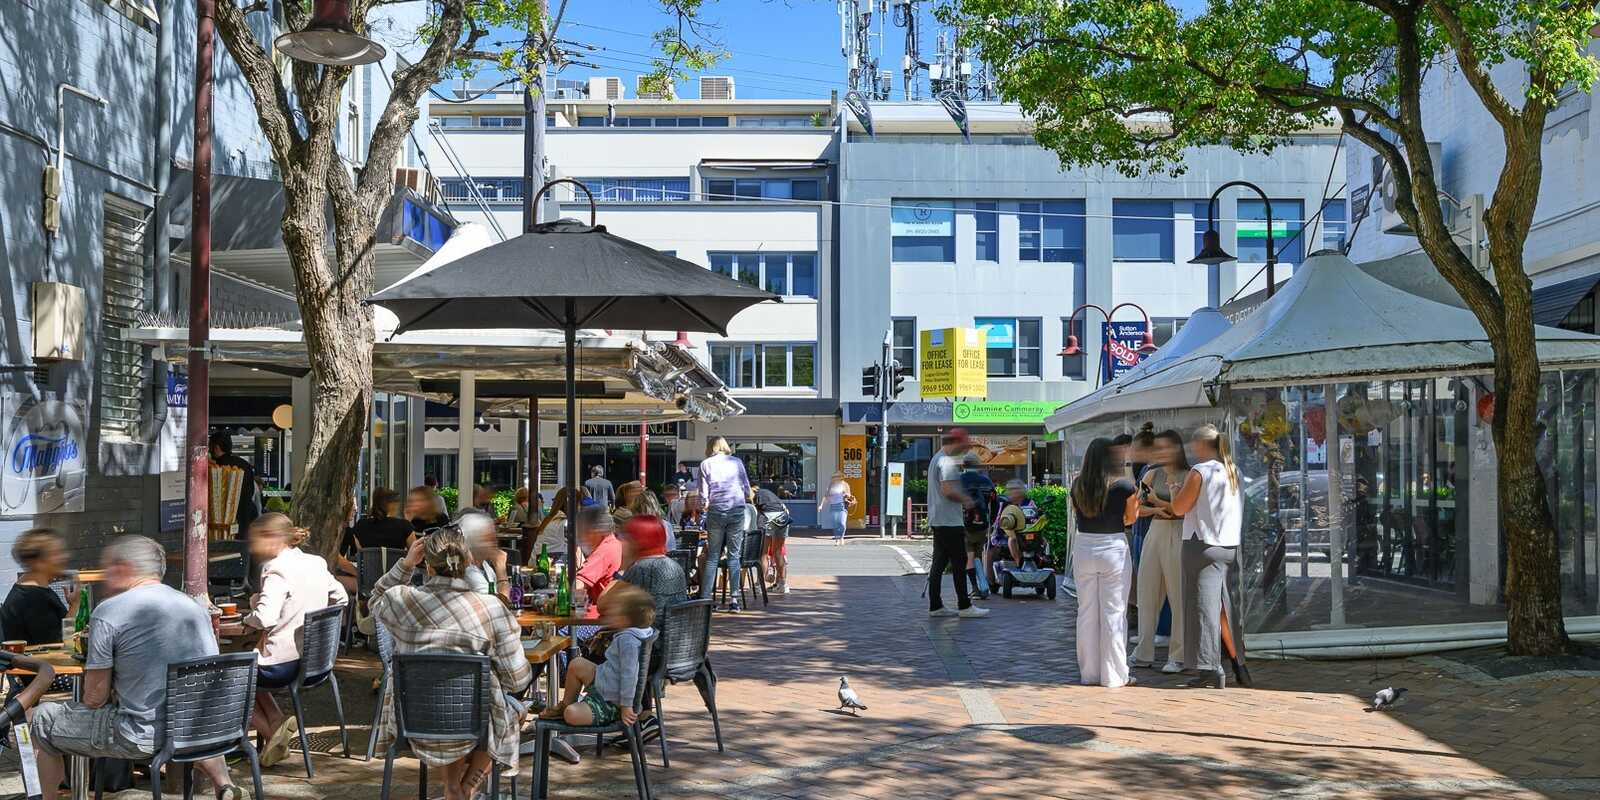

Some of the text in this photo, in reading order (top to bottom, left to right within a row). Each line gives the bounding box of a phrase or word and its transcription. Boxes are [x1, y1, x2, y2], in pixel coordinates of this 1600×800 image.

[1120, 340, 1141, 350] ALE
[927, 350, 946, 360] OFFICE
[962, 350, 980, 359] OFFICE
[1110, 343, 1135, 362] SOLD
[922, 360, 953, 370] FOR LEASE
[958, 360, 985, 370] FOR LEASE
[922, 383, 953, 393] 9969 1500
[973, 404, 1003, 412] Jasmine
[614, 423, 635, 434] TELL
[843, 448, 862, 461] 506
